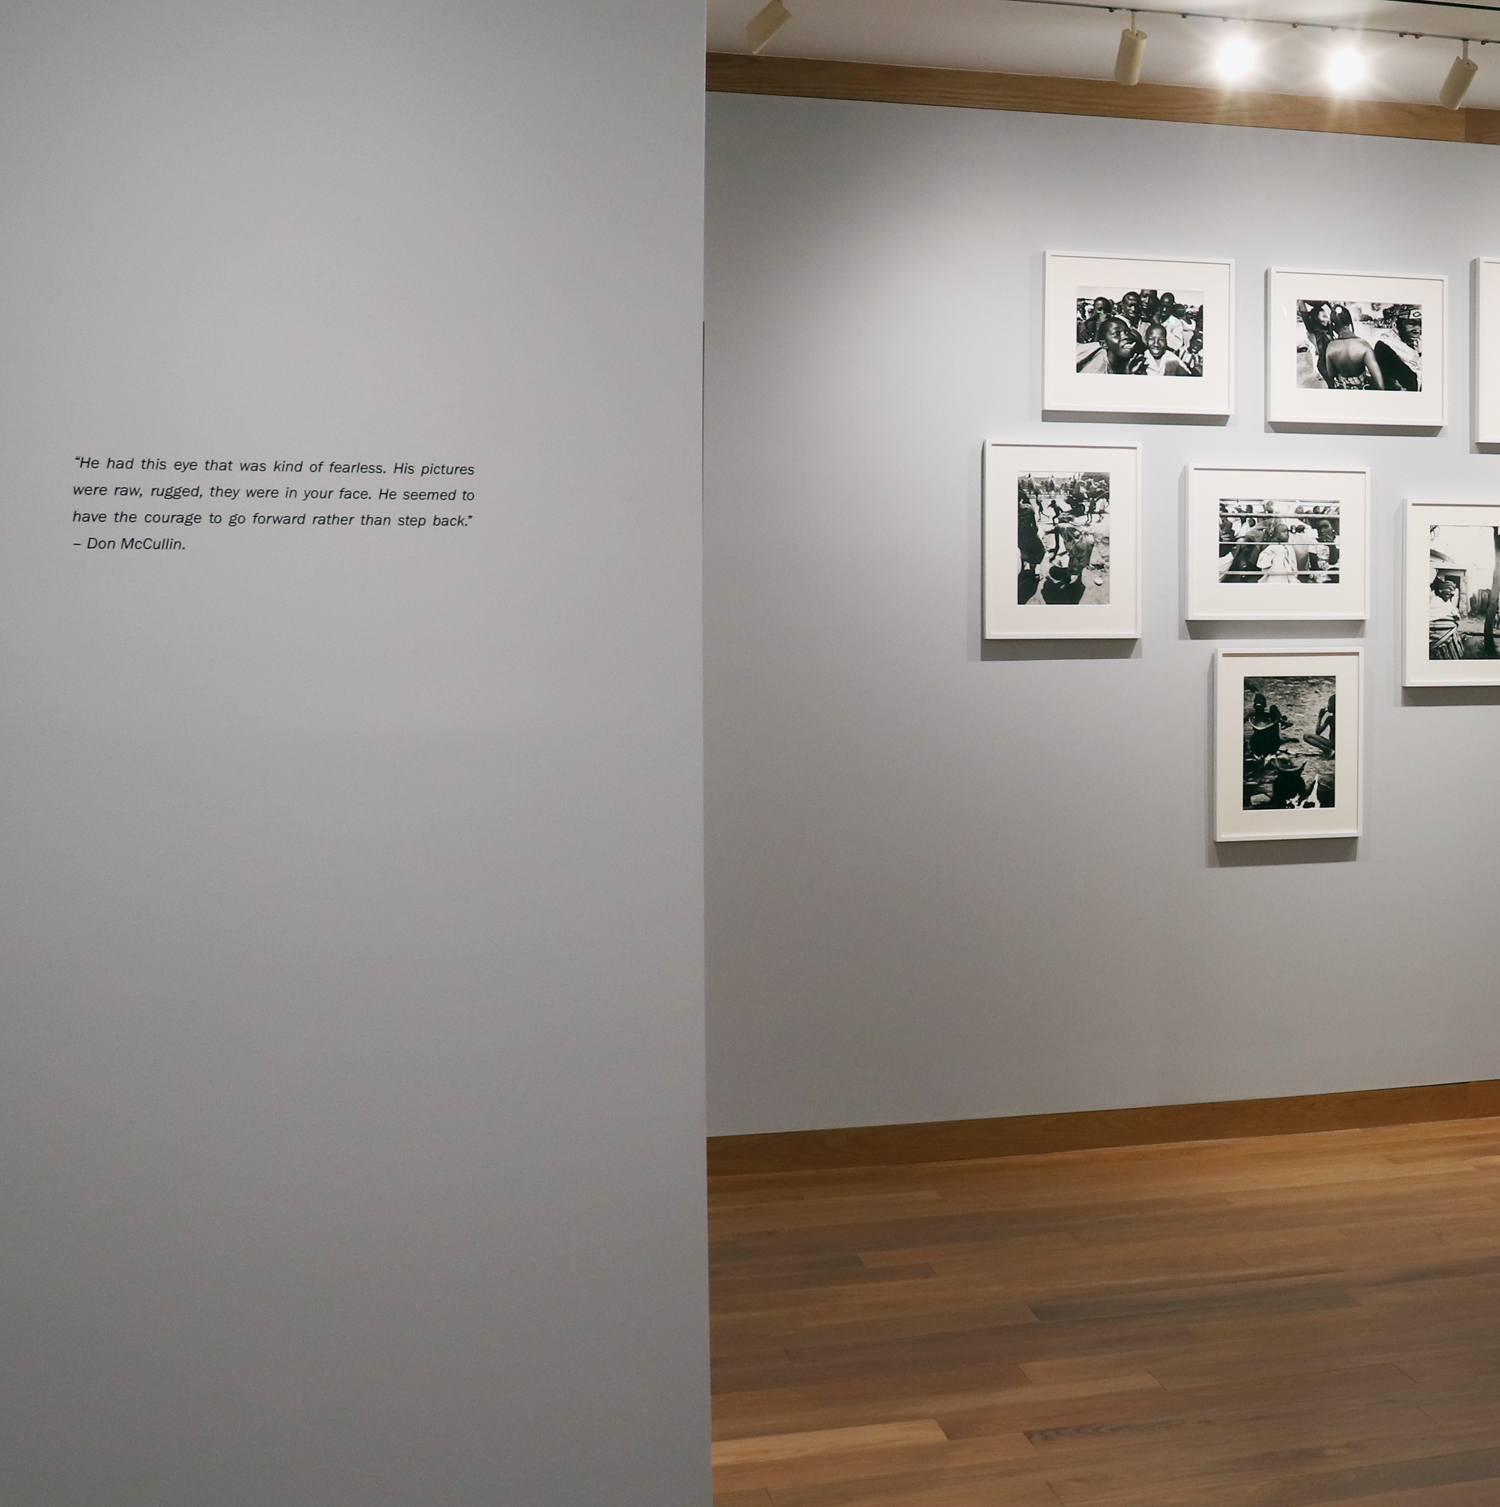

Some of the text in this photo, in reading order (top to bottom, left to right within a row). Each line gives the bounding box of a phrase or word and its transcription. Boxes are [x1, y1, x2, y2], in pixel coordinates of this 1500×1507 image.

[106, 456, 135, 469] had
[140, 457, 167, 470] this
[173, 460, 199, 473] eye
[204, 458, 234, 471] that
[239, 462, 267, 472] was
[272, 460, 304, 472] kind
[308, 460, 325, 472] of
[328, 460, 387, 474] fearless.
[393, 462, 415, 474] His
[420, 462, 475, 477] pictures
[72, 485, 475, 501] were raw, rugged, they were in your face. He seemed to
[72, 510, 108, 522] have
[113, 510, 138, 523] the
[143, 512, 203, 526] courage
[208, 512, 223, 524] to
[227, 513, 247, 527] go
[252, 512, 307, 525] forward
[311, 513, 356, 525] rather
[360, 513, 392, 525] than
[397, 515, 427, 528] step
[86, 536, 116, 549] Don
[120, 537, 186, 550] McCullin.
